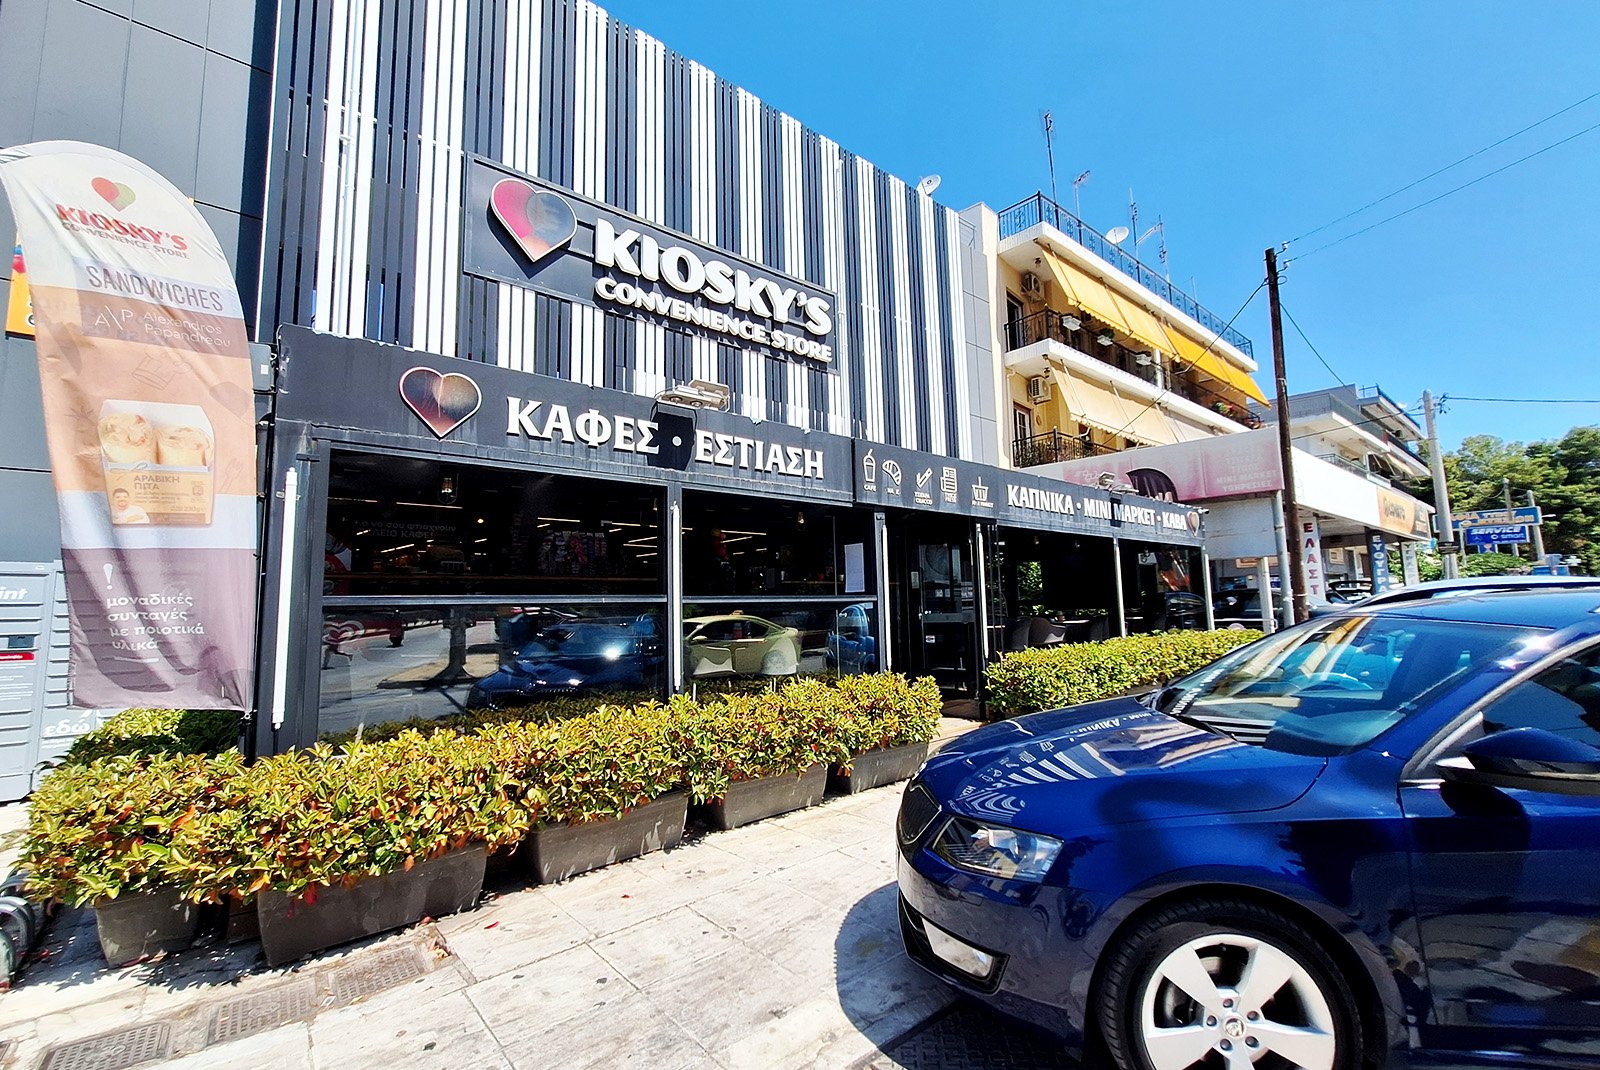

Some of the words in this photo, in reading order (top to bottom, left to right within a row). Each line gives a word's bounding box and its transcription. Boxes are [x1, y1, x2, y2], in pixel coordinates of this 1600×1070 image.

[55, 203, 188, 251] KIOSKY'S
[61, 221, 150, 250] CONVENIENCE
[153, 244, 190, 259] STORE
[86, 265, 223, 312] SANDWICHES
[595, 218, 832, 336] KIOSKY'S
[143, 311, 223, 335] Alexandros
[595, 276, 770, 345] CONVENIENCE
[770, 330, 832, 362] STORE
[145, 324, 231, 347] Papandreou
[506, 396, 660, 456] ΚΑΦΕΣ
[694, 429, 825, 480] ΕΣΤΙΑΣΗ
[133, 475, 180, 483] ΑΡΑΒΙΚΗ
[134, 482, 160, 490] ΠΙΤΑ
[1006, 484, 1075, 515] ΚΑΠΝΙΚΑ
[1114, 503, 1156, 526] ΜΑΡΚΕΤ
[1162, 511, 1187, 531] ΚΑΒΑ
[1470, 526, 1522, 535] SERVICE
[106, 593, 193, 609] μοναδικές
[107, 608, 188, 622] συνταγές
[110, 627, 129, 637] με
[134, 622, 205, 635] ποιοτικά
[112, 638, 158, 651] υλικά
